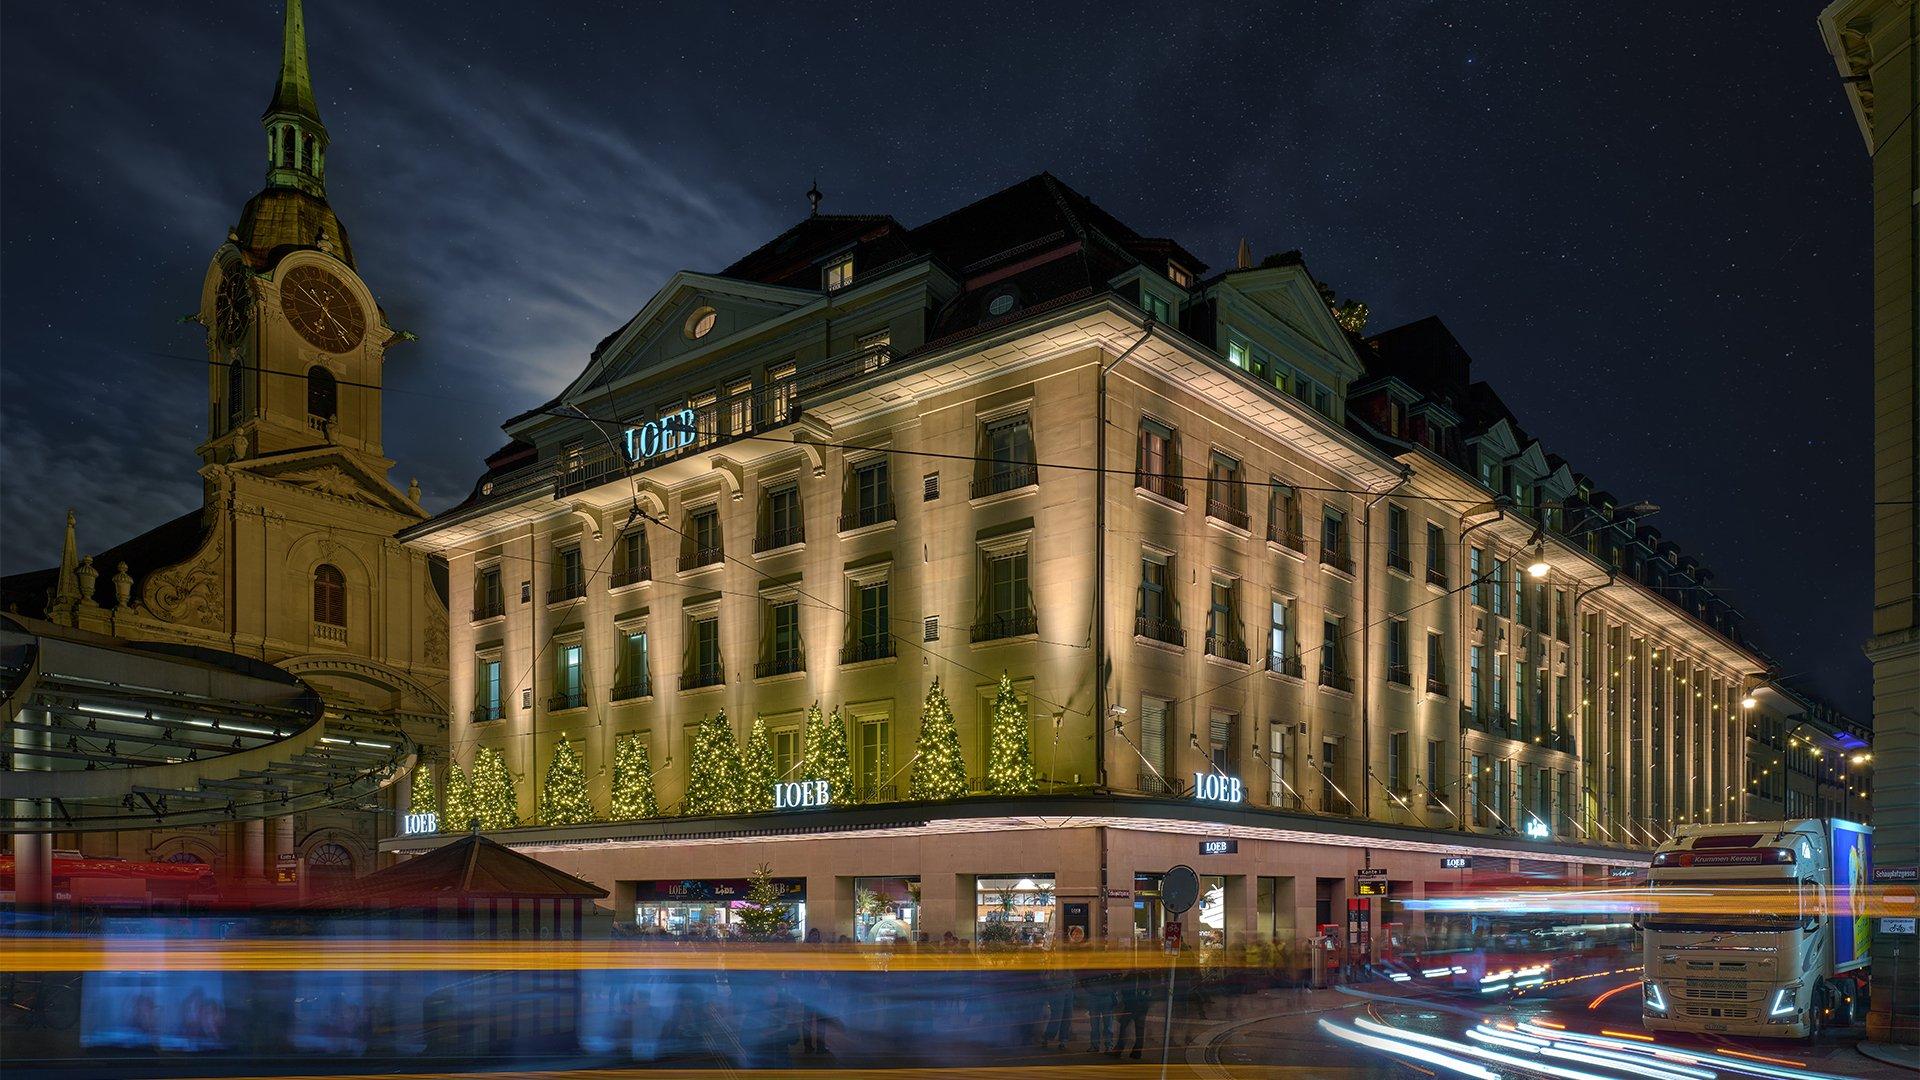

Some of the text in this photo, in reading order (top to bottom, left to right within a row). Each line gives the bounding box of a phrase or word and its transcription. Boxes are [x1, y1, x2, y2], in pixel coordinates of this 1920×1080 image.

[625, 408, 696, 462] LOEB
[774, 780, 829, 808] LOEB
[1195, 772, 1242, 803] LOEB
[404, 813, 437, 834] LOEB
[1205, 842, 1227, 852] LOEB
[1446, 859, 1465, 867] LOEB
[1875, 870, 1916, 879] Schauplatzgasse
[668, 884, 688, 895] LOEB
